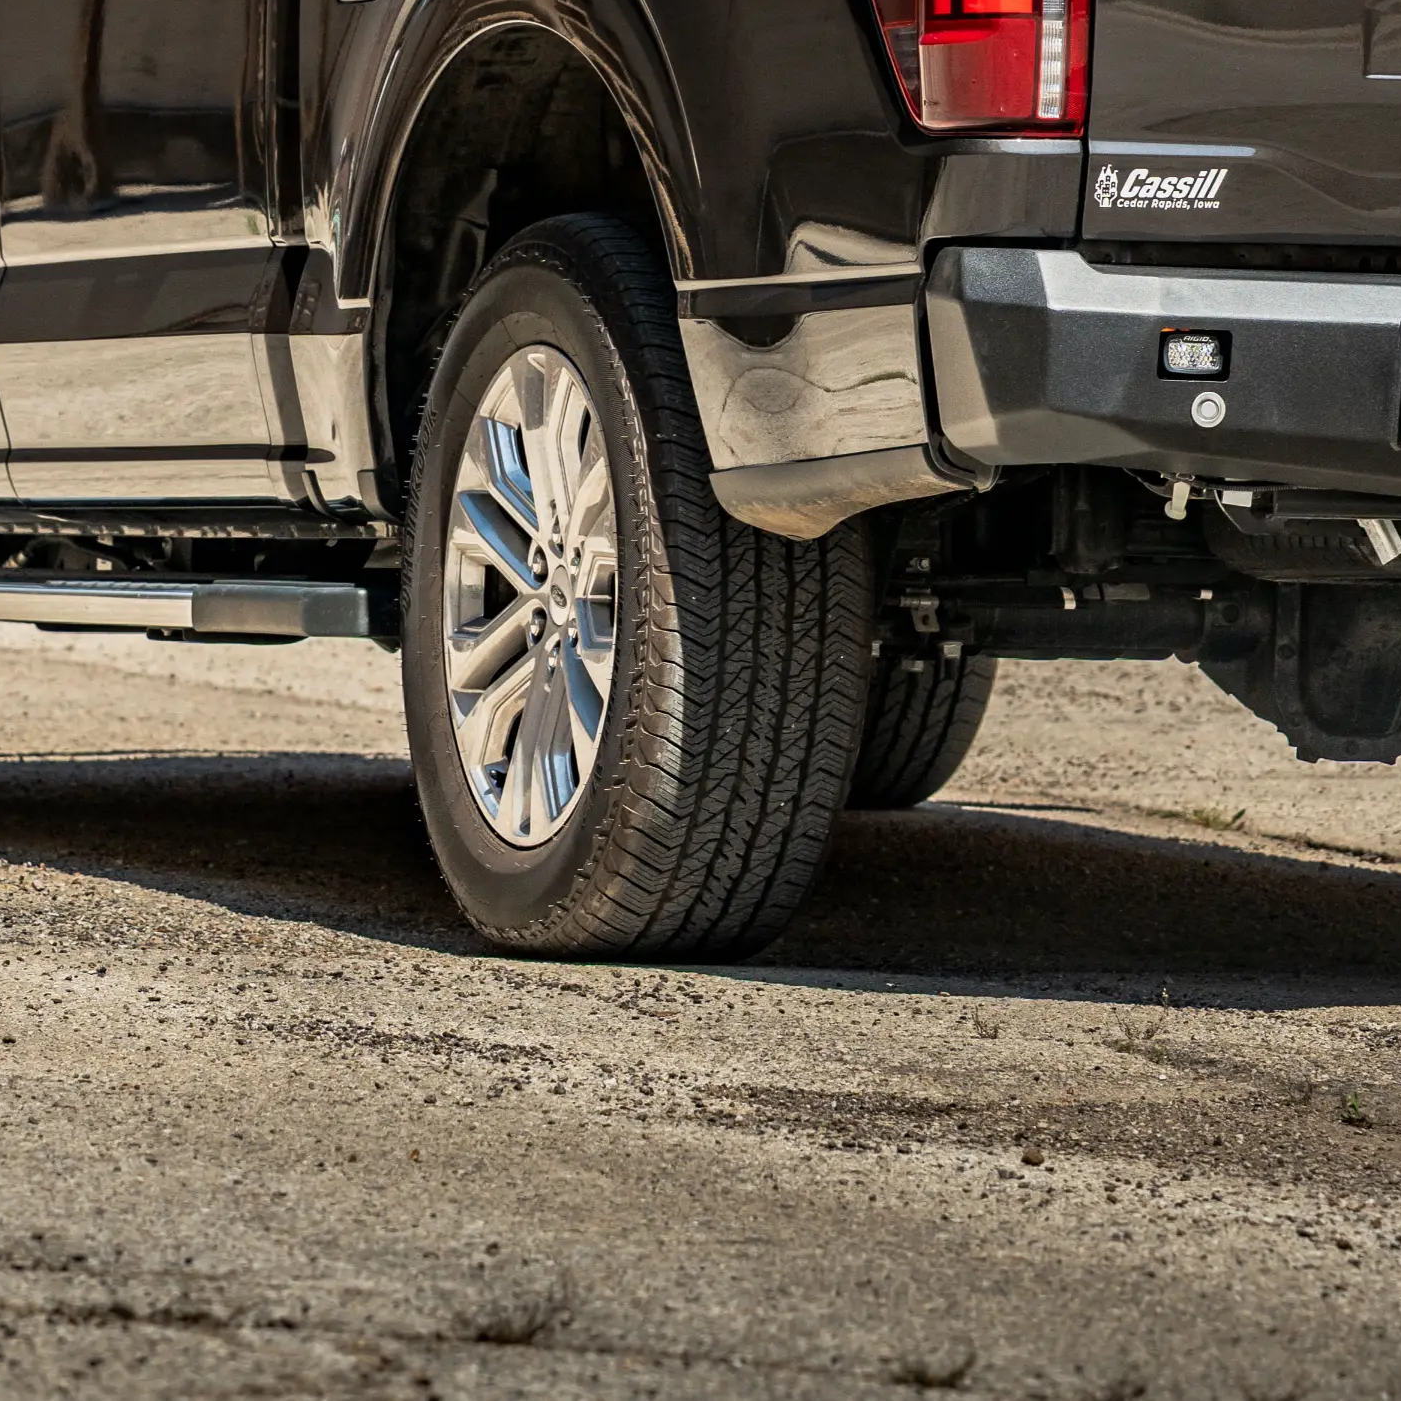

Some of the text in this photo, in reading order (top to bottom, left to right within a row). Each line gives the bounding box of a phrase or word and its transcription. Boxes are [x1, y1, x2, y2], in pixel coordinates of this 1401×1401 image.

[1119, 168, 1229, 199] Cassill
[1116, 199, 1220, 210] Cedar Rapids, Iowa
